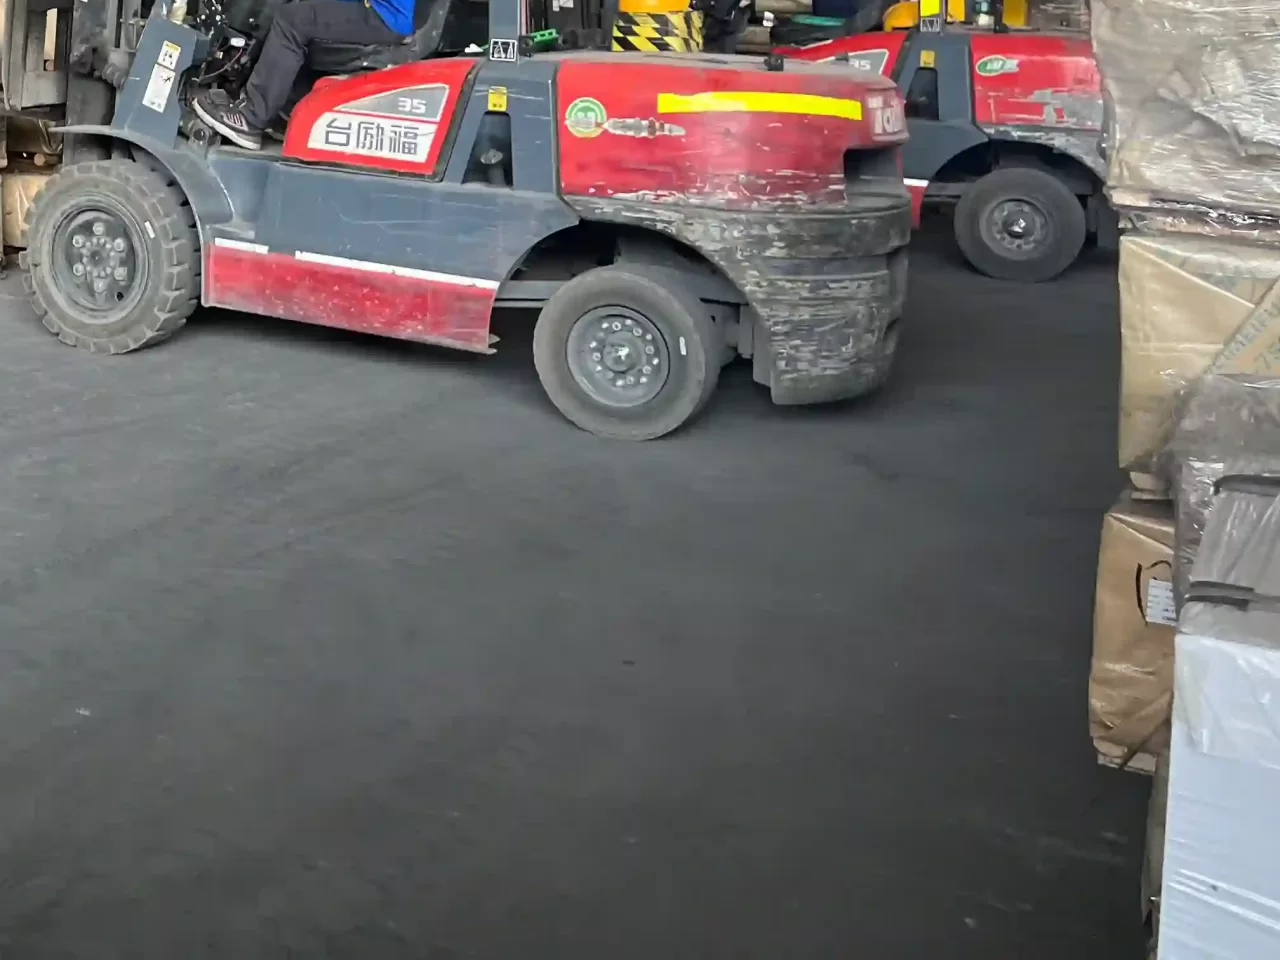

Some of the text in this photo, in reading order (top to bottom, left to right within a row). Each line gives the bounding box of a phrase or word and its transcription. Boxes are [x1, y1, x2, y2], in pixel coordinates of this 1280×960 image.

[398, 96, 428, 114] 35
[324, 118, 420, 156] 台励福
